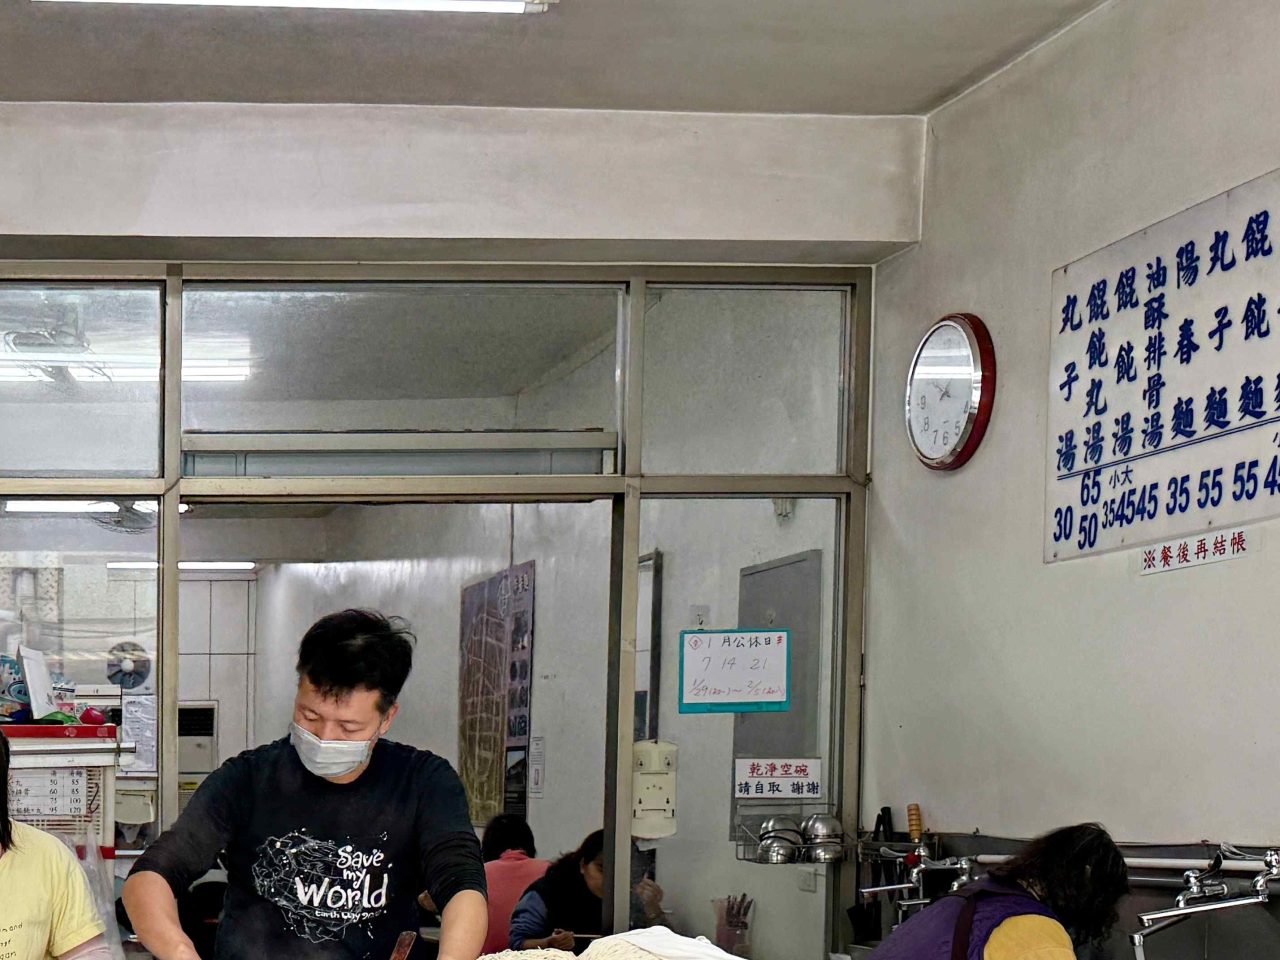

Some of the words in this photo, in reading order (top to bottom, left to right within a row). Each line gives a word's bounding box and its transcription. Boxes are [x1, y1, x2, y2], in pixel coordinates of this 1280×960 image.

[1203, 230, 1237, 431] 丸子麵
[1238, 210, 1273, 421] 餛飩麵
[1141, 256, 1169, 450] 油酥排骨湯
[1171, 240, 1200, 440] 陽春麵
[1083, 278, 1110, 465] 餛飩丸湯
[1112, 266, 1139, 457] 餛飩湯
[1056, 294, 1083, 472] 丸子湯
[1081, 468, 1102, 507] 65
[1166, 474, 1191, 515] 35
[1197, 467, 1223, 509] 55
[1232, 459, 1259, 501] 55
[1053, 505, 1073, 542] 30
[1078, 512, 1098, 550] 50
[721, 656, 736, 670] 14
[750, 657, 767, 670] 21
[738, 781, 782, 795] 請自取
[790, 781, 819, 795] 謝謝
[748, 762, 809, 776] 乾淨空碗
[336, 845, 384, 869] Save
[294, 873, 389, 909] World
[343, 868, 367, 889] my
